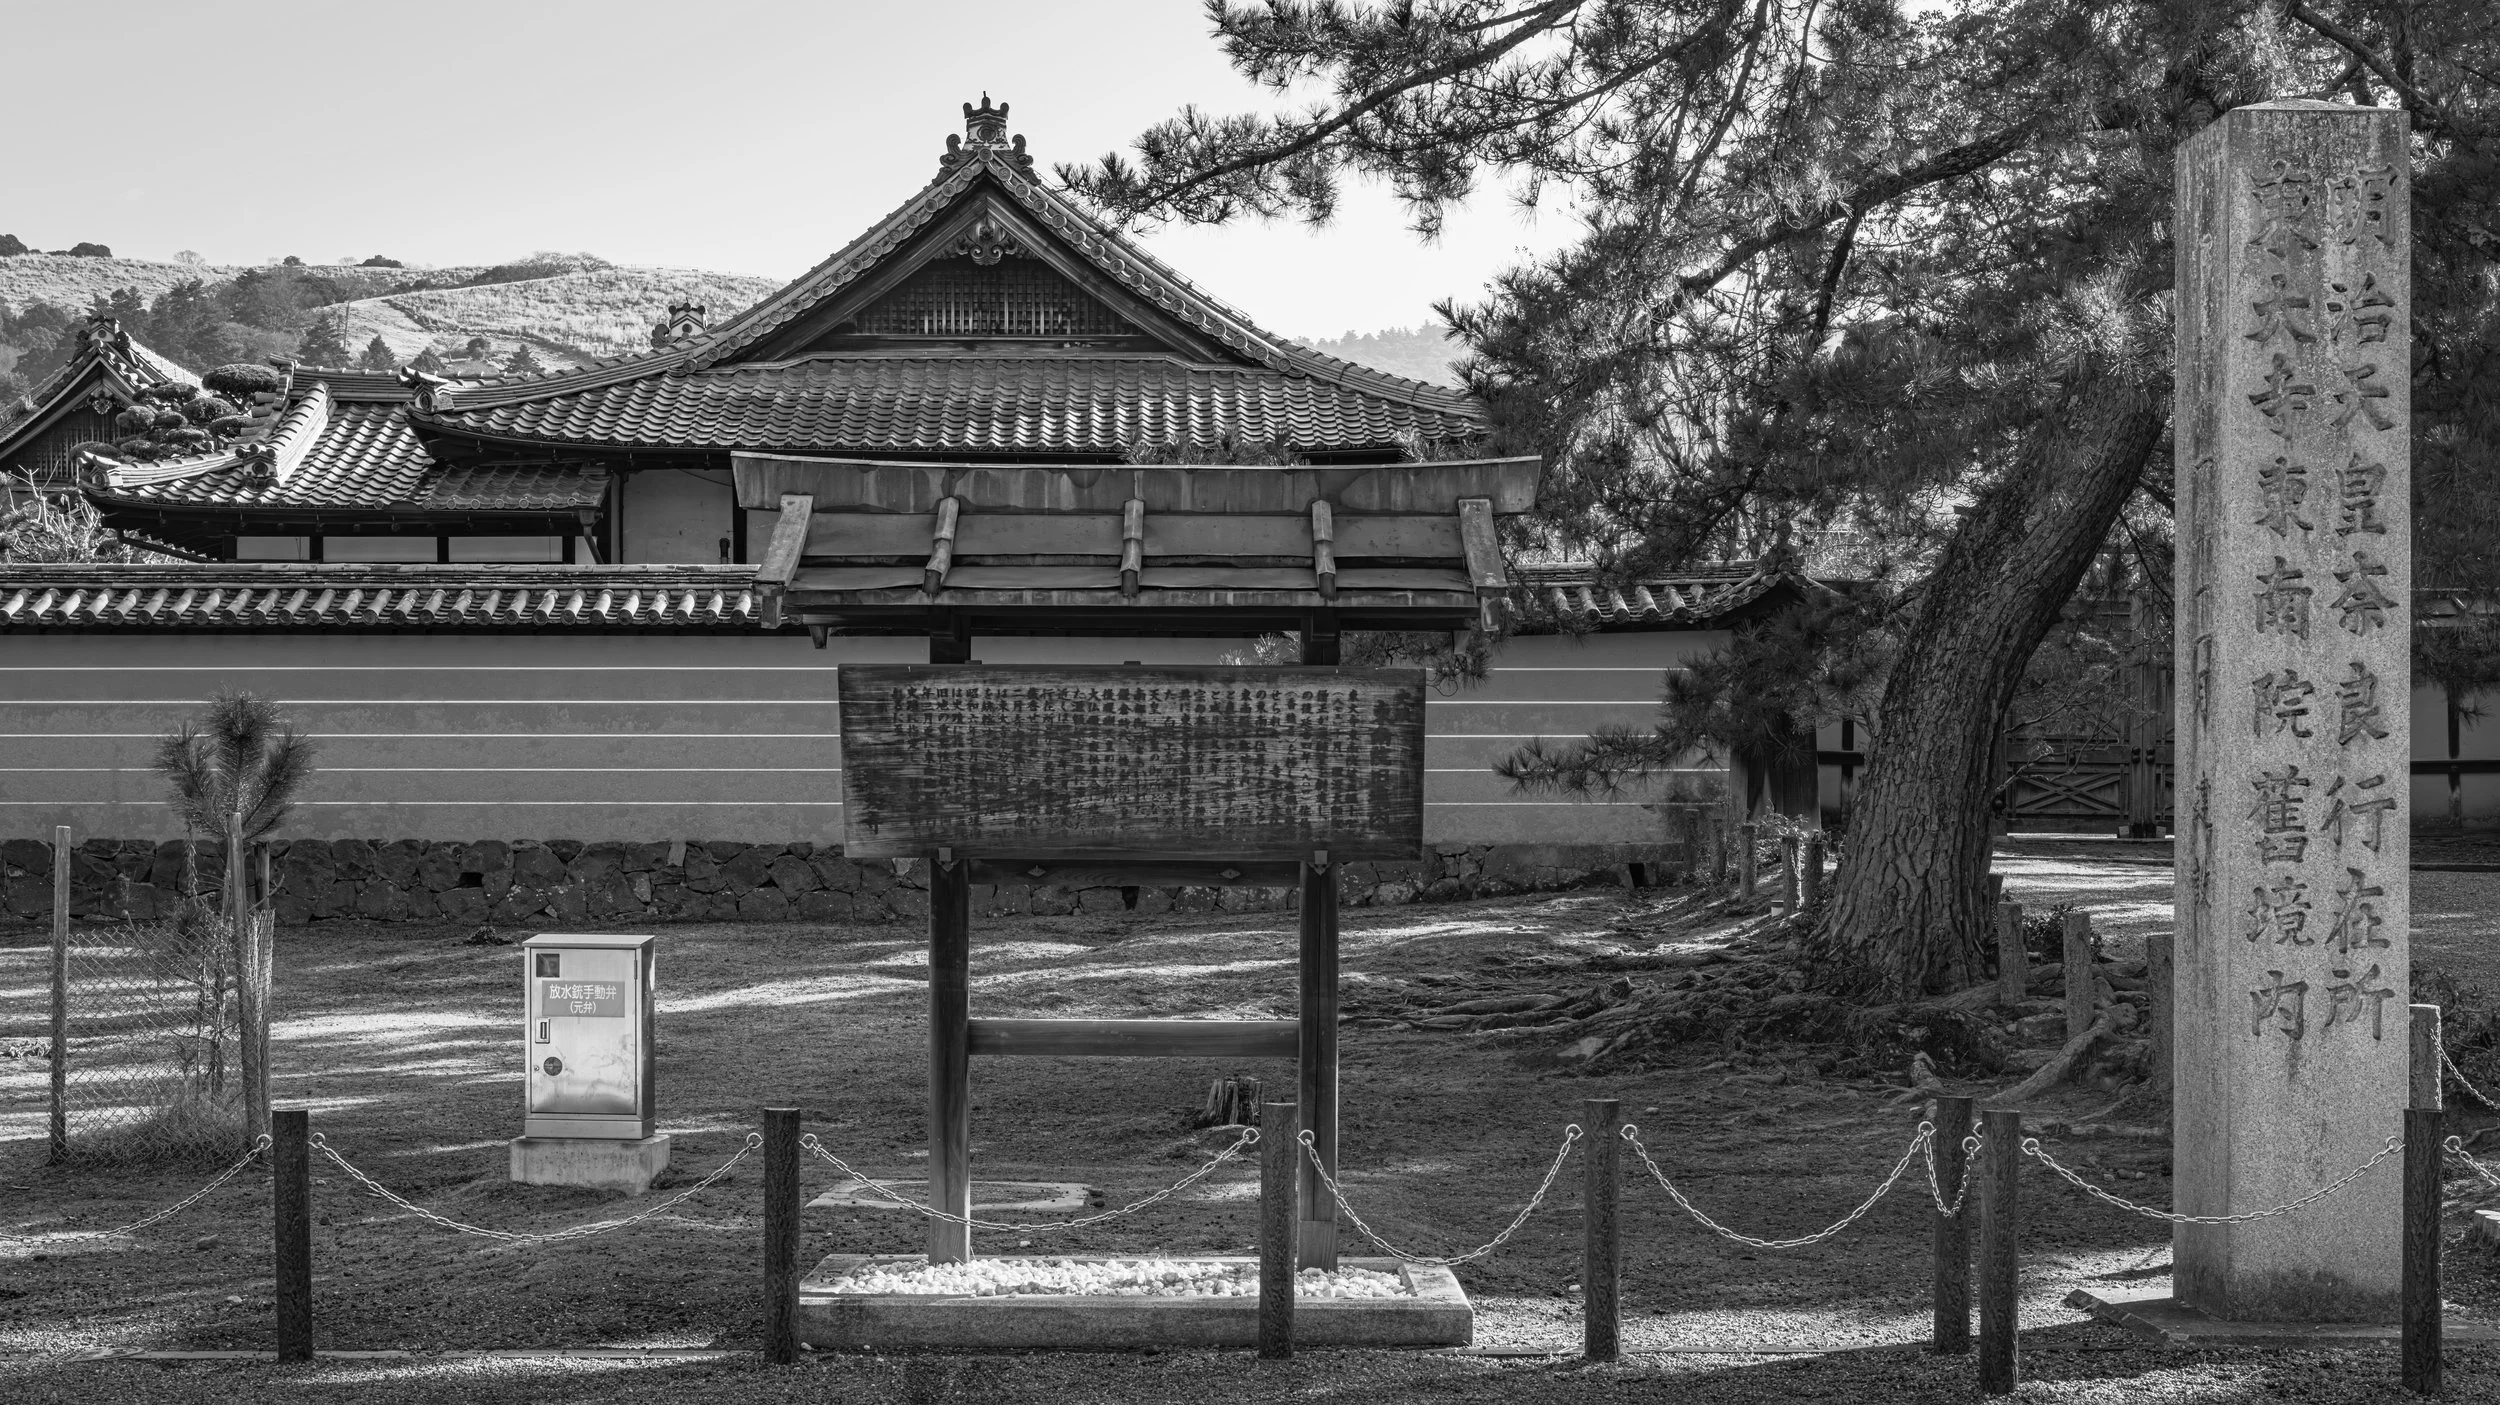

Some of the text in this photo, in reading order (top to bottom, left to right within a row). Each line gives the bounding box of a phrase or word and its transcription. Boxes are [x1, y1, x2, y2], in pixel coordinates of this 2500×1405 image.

[2321, 163, 2399, 1041] 明治天皇奈良行在所
[549, 984, 617, 1000] 放水銃手動弁
[570, 1001, 597, 1014] (元弁)
